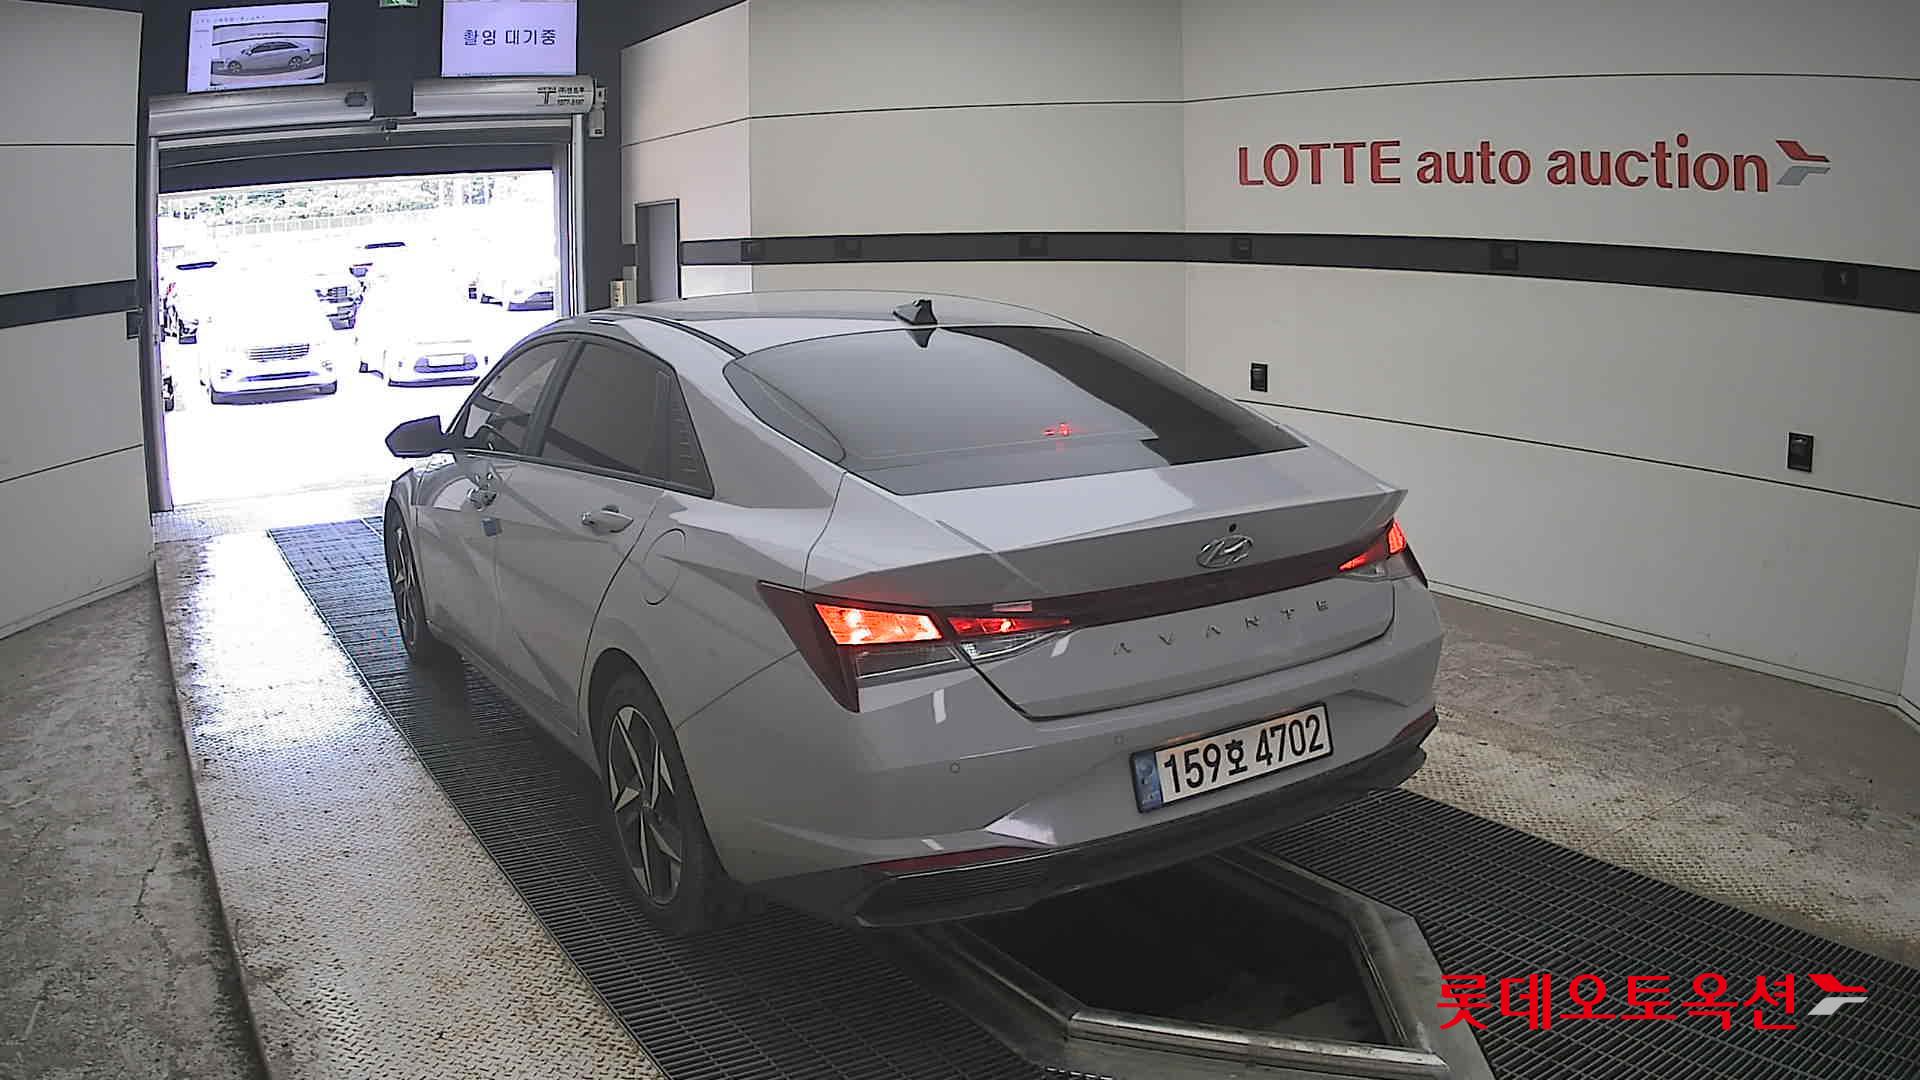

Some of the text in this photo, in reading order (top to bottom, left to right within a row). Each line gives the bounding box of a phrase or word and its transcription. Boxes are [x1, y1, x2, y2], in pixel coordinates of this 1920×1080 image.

[505, 29, 556, 46] 대기중
[1238, 133, 1770, 193] LOTTE auto auction
[1113, 600, 1329, 656] AVANTE
[1164, 714, 1324, 794] 159호 4702
